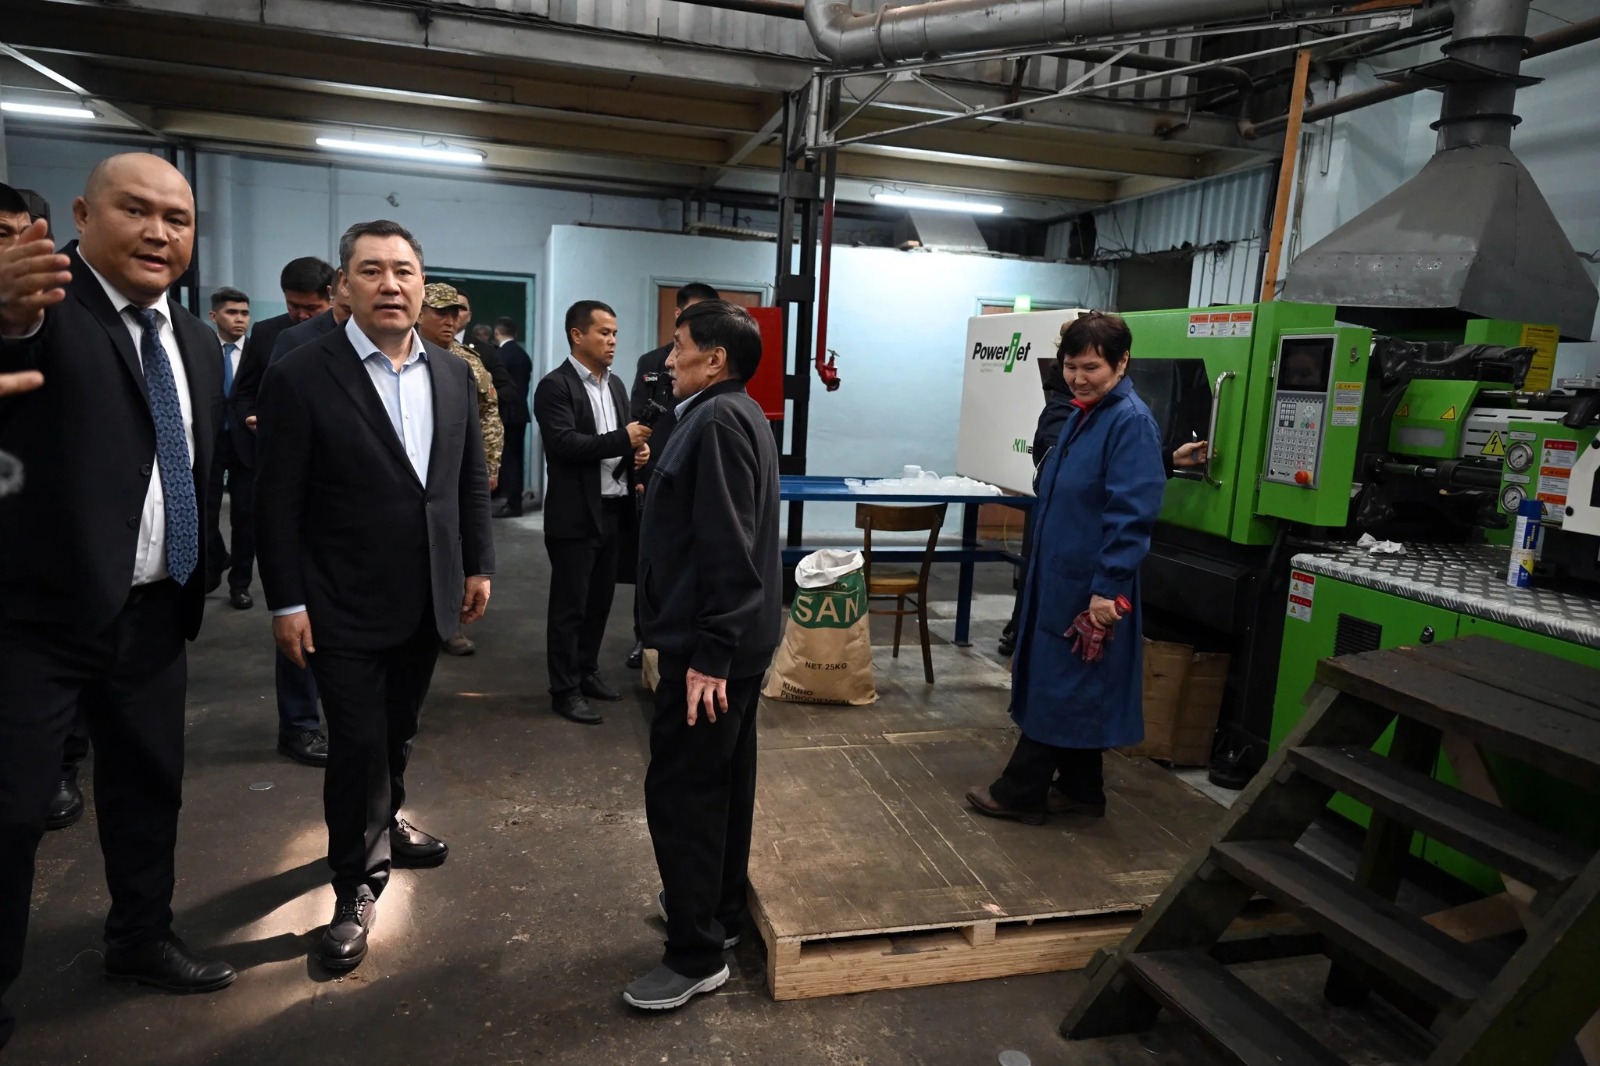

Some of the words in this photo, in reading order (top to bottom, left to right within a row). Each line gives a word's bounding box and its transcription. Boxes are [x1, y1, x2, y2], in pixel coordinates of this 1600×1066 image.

[972, 337, 1031, 367] Powerjet
[795, 594, 860, 623] SAN
[805, 661, 822, 670] NET
[825, 662, 847, 671] 25KG
[782, 681, 813, 696] KUMHO
